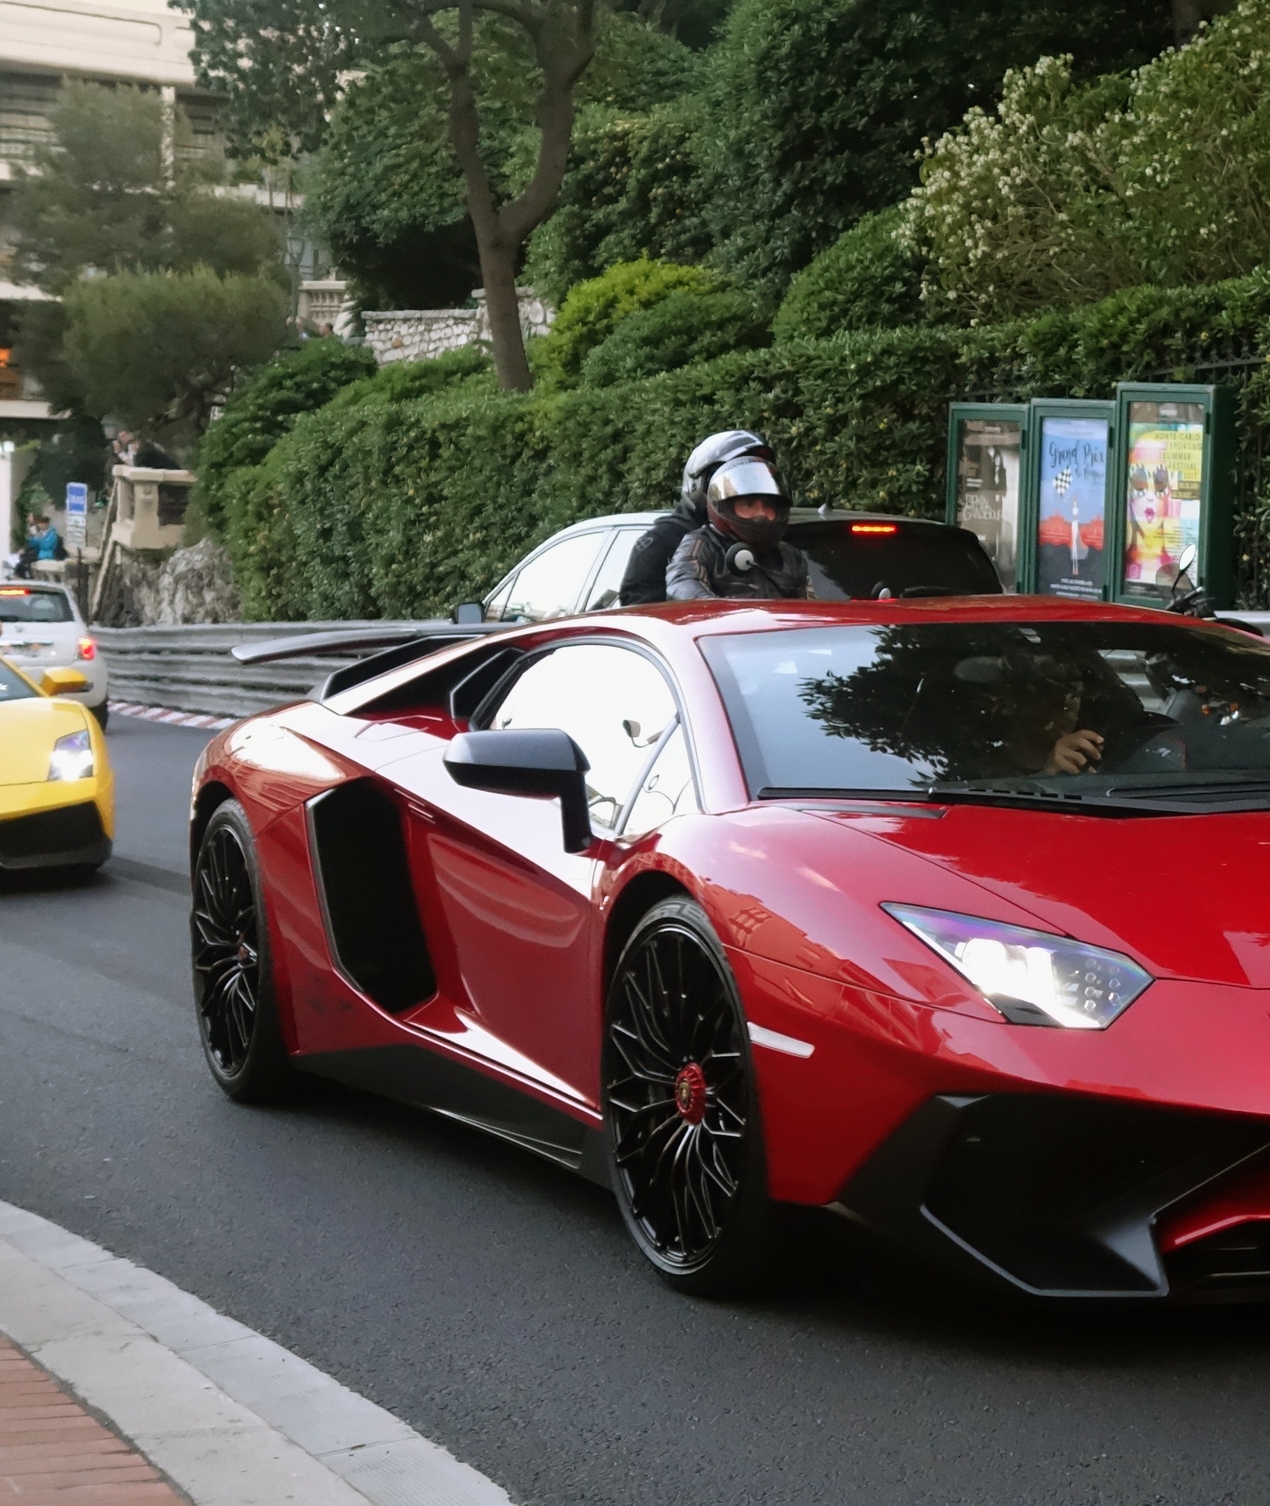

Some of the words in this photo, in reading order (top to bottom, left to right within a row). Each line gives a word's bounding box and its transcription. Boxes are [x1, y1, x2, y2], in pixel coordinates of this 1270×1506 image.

[1154, 433, 1177, 441] MONTE
[1180, 433, 1201, 441] CARLO
[1169, 442, 1203, 450] SPORTING
[1083, 442, 1105, 467] Prix
[1162, 452, 1191, 460] SUMMER
[1168, 462, 1197, 471] FESTIVAL
